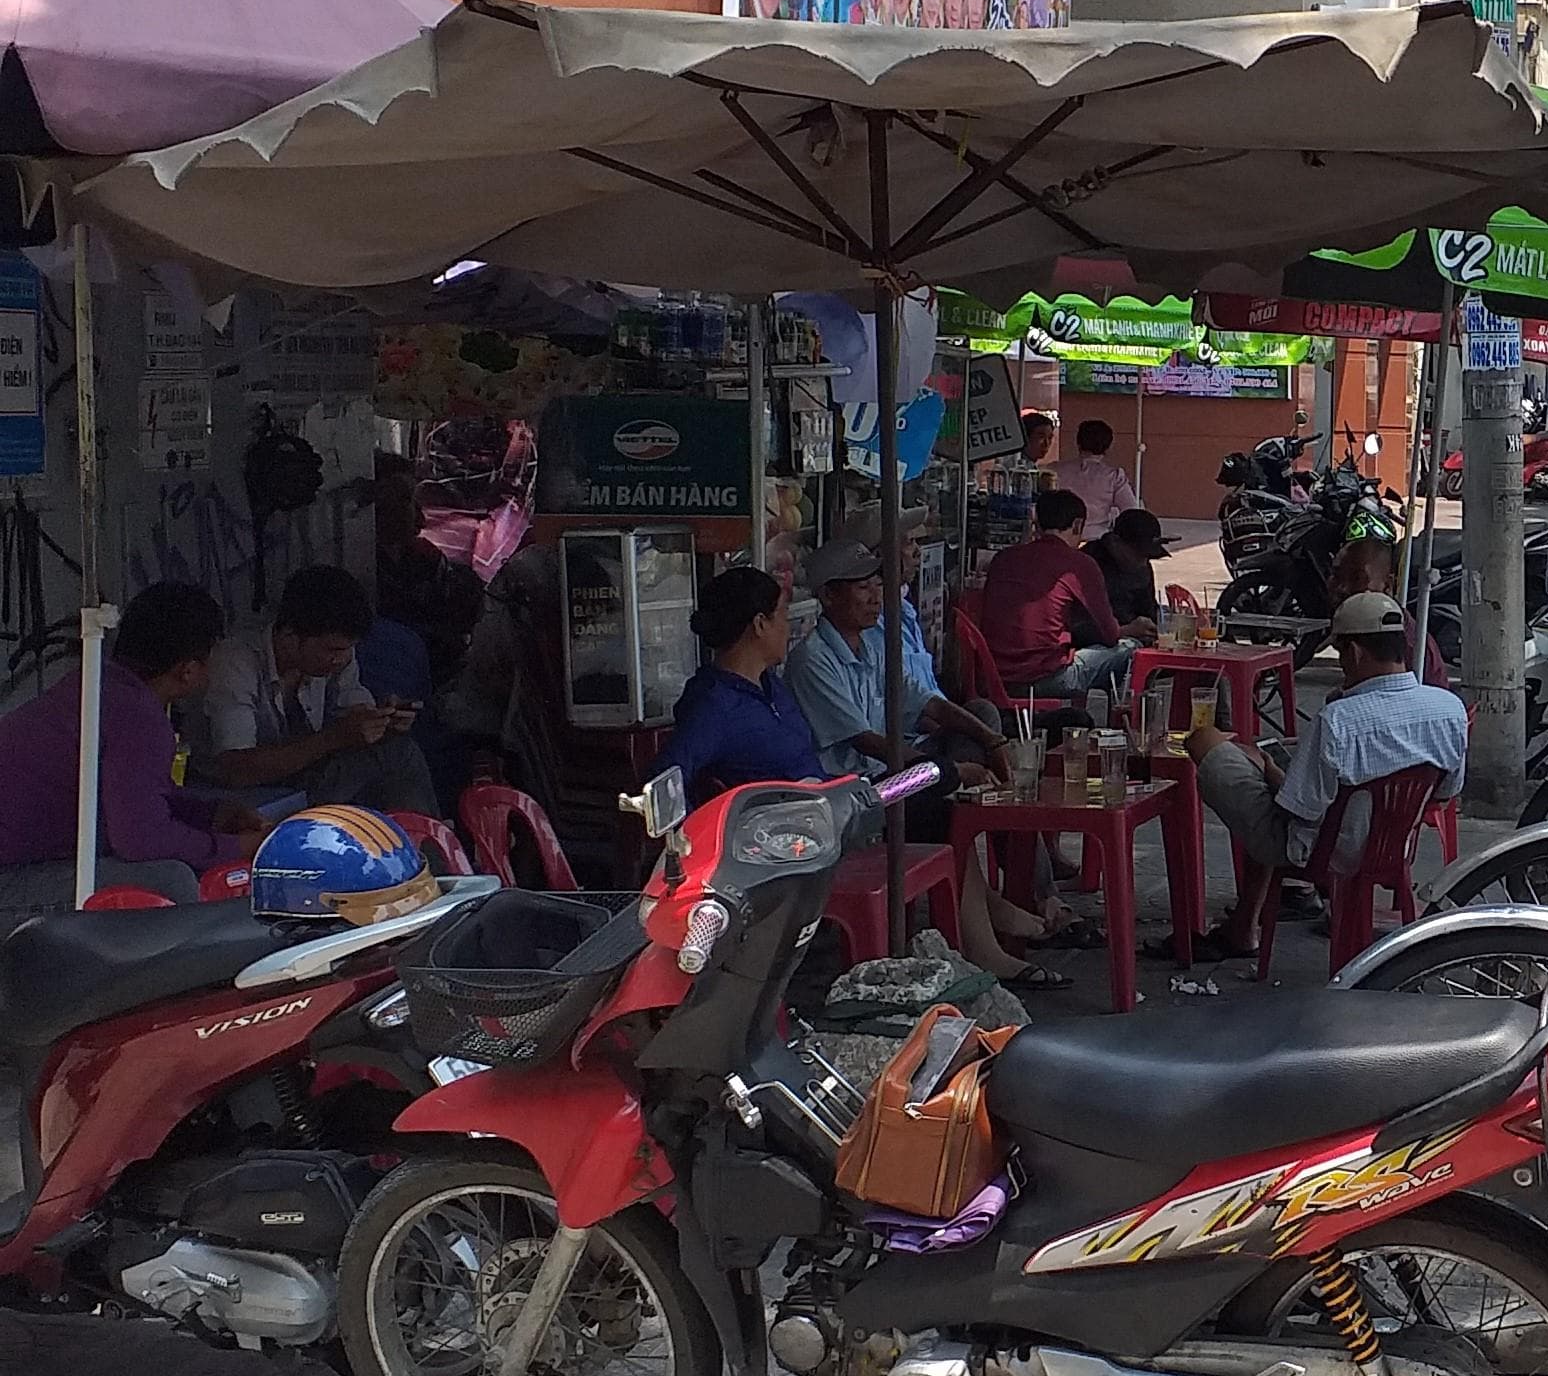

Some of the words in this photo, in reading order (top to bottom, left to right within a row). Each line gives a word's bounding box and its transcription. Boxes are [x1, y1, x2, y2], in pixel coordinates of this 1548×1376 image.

[1437, 230, 1493, 282] C2
[1497, 241, 1537, 274] MÁT
[1050, 308, 1082, 341] C2
[1303, 302, 1414, 336] COMPACT
[616, 481, 664, 506] BÁN
[670, 481, 738, 507] HÀNG
[194, 996, 313, 1039] VISION
[1359, 1162, 1453, 1211] wave
